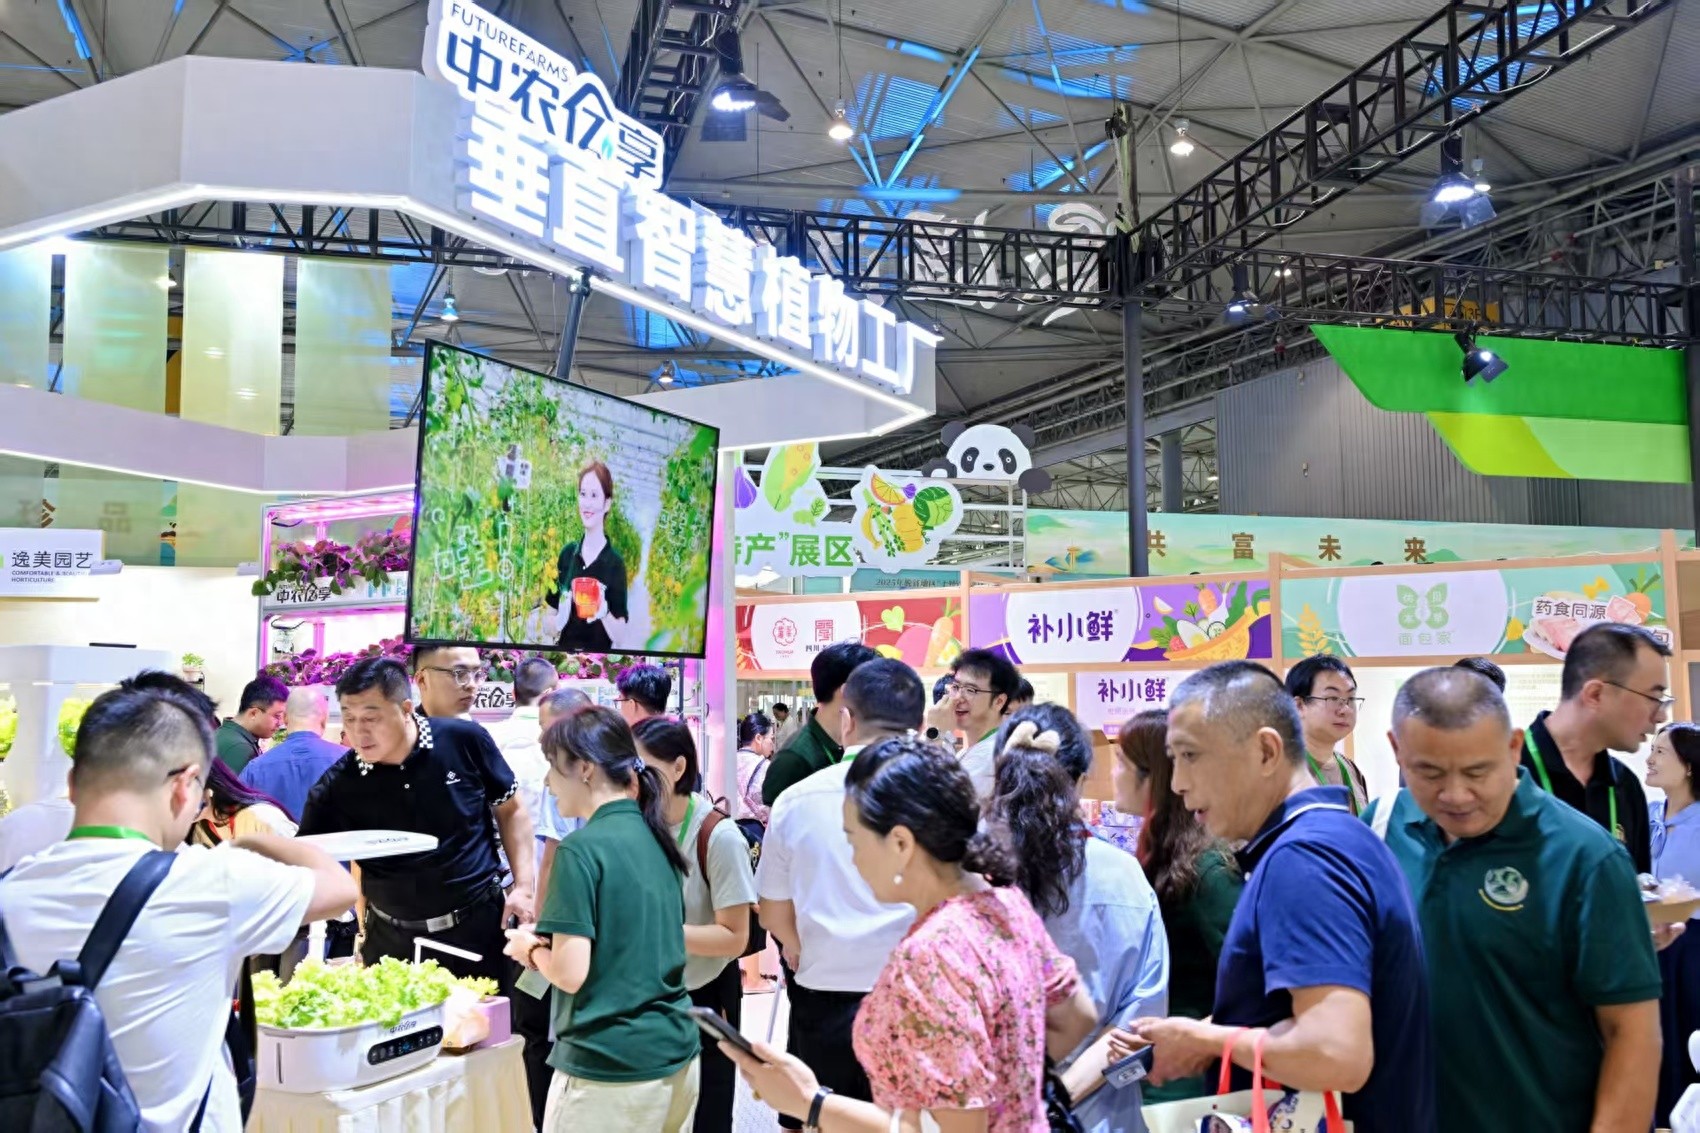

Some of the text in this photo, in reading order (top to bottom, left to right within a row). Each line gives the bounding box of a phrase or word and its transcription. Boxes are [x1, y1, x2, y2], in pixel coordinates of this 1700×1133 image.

[451, 3, 570, 82] FUTUREFARMS
[446, 31, 658, 179] 中农亿享
[467, 103, 945, 395] 垂直智慧植物工厂
[11, 551, 94, 569] 逸美园艺
[1027, 609, 1114, 644] 补小鲜
[1535, 600, 1608, 620] 药食同源
[1097, 678, 1166, 703] 补小鲜
